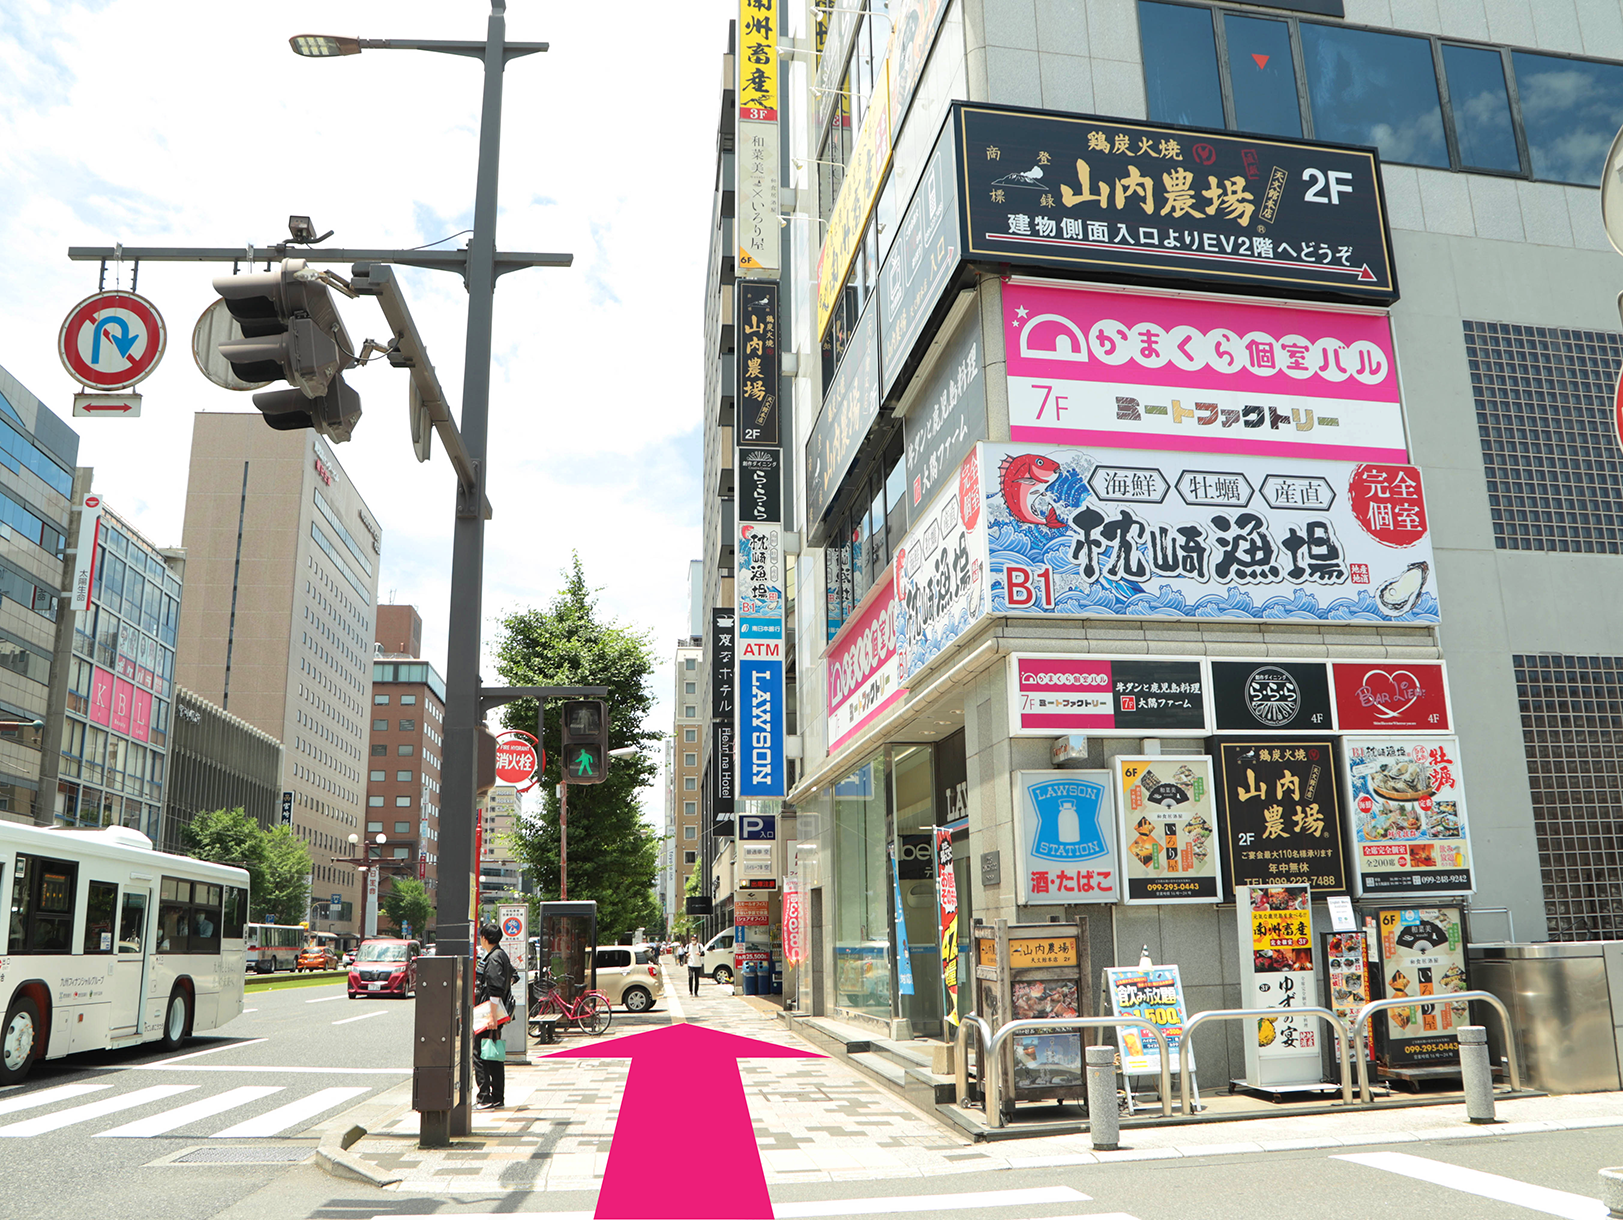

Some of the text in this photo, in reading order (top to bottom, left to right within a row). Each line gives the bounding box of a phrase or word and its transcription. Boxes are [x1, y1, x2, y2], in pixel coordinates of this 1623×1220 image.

[750, 109, 767, 119] 3F
[1087, 130, 1184, 161] 鶏炭火焼
[1060, 158, 1255, 227] 山内農場
[1262, 170, 1285, 220] 天文館本店
[1302, 168, 1353, 205] 2F
[1007, 213, 1353, 266] 建物側面入口よりEV2階へどうぞ
[743, 315, 766, 401] 山内農場
[1093, 329, 1382, 377] かまくら個室バル
[1031, 384, 1068, 421] 7F
[1115, 396, 1339, 432] ミートファクトリー
[745, 429, 761, 440] 2F
[1104, 472, 1156, 497] 海鮮
[1189, 475, 1240, 502] 牡蠣
[1274, 480, 1324, 506] 産直
[1362, 469, 1418, 499] 完全
[1367, 502, 1423, 532] 個室
[1072, 507, 1347, 581] 枕崎漁場
[77, 569, 88, 602] 太陽生命
[1005, 566, 1054, 608] B1
[742, 602, 755, 613] B1
[752, 625, 780, 633] 南日本銀行
[743, 644, 779, 656] ATM
[718, 633, 732, 712] 変なホテル
[1039, 673, 1107, 685] かまくら個室バル
[96, 683, 145, 726] K B L
[1021, 695, 1035, 710] 7F
[1039, 699, 1107, 708] ミートファクトリー
[1122, 698, 1134, 709] 7F
[752, 670, 771, 785] LAWSON
[1311, 714, 1323, 723] 4F
[1428, 714, 1440, 723] 4F
[497, 752, 532, 771] 消火栓
[722, 757, 729, 769] na
[1429, 745, 1455, 792] 牡蠣
[1125, 768, 1138, 777] 6F
[722, 772, 731, 798] Hotel
[1036, 786, 1097, 799] LAWSON
[1237, 768, 1300, 802] 山内
[743, 817, 764, 838] P
[1262, 803, 1324, 839] 農場
[760, 831, 774, 839] 入口
[1238, 833, 1255, 846] 2F
[1040, 842, 1099, 856] STATION
[1241, 849, 1333, 860] ご宴会最大110名様承ります
[1268, 862, 1310, 874] 年中無休
[1366, 858, 1395, 867] 全200席
[1147, 883, 1199, 891] 099-295-0443
[1422, 875, 1467, 884] 099-248-9242
[1383, 915, 1395, 925] 6F
[1023, 942, 1069, 955] 山内農場
[1117, 985, 1177, 1006] 飲み放題
[1405, 1043, 1458, 1053] 099-295-0443
